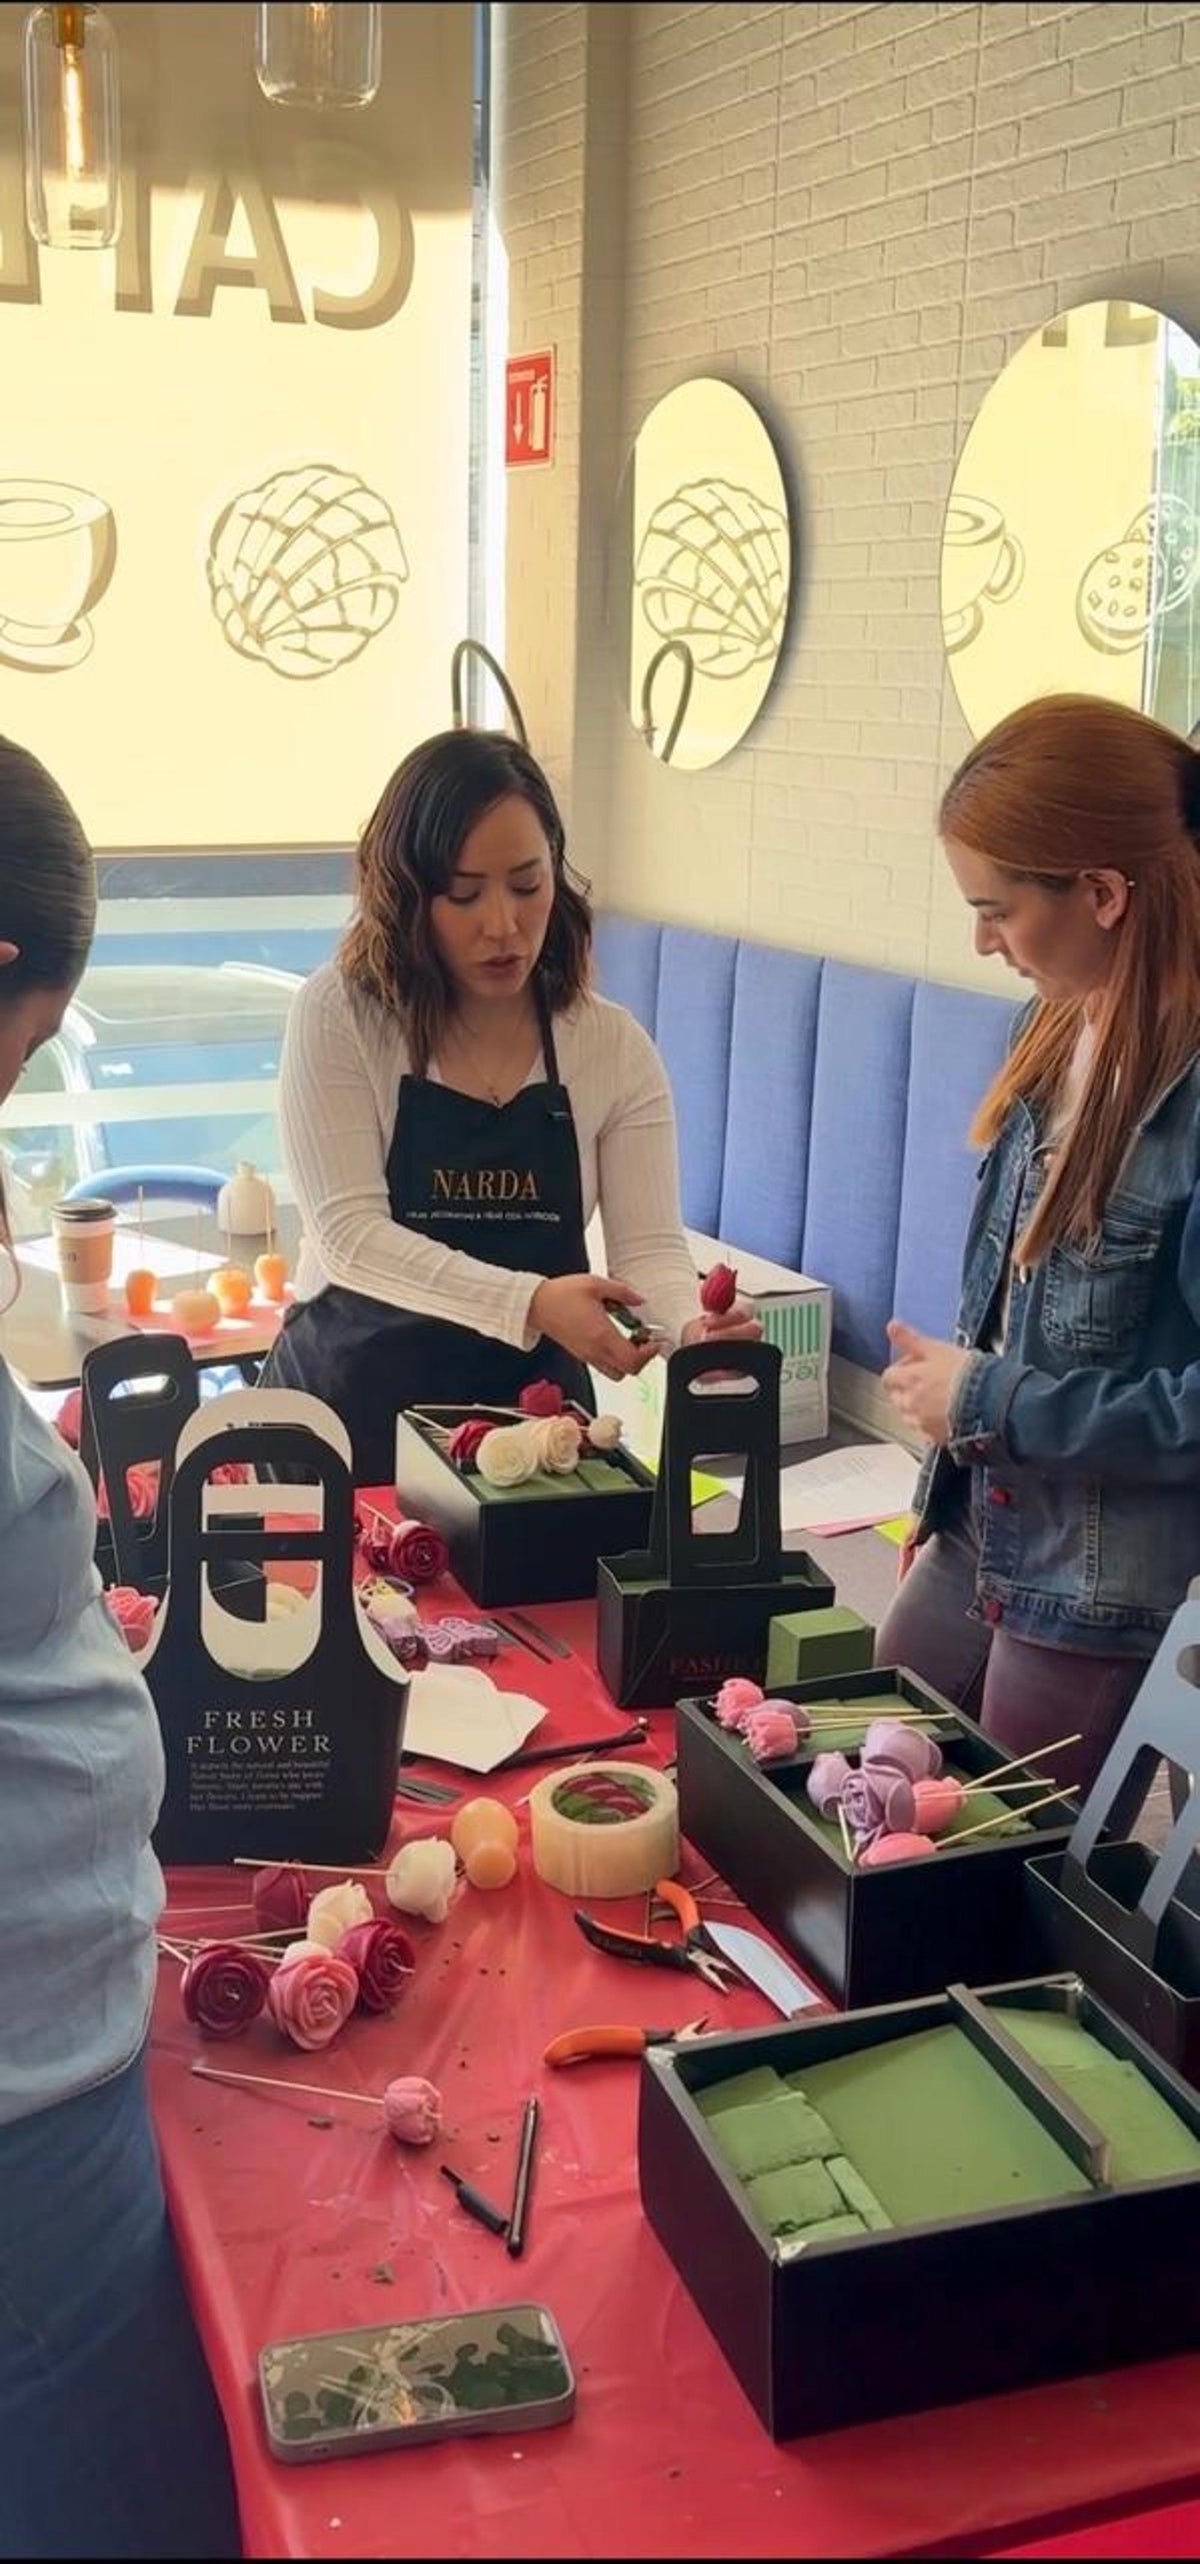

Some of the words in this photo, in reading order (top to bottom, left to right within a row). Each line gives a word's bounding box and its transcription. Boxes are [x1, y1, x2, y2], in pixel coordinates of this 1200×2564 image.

[431, 1169, 539, 1200] NARDA
[204, 1710, 313, 1729] FRESH
[187, 1734, 332, 1755] FLOWER
